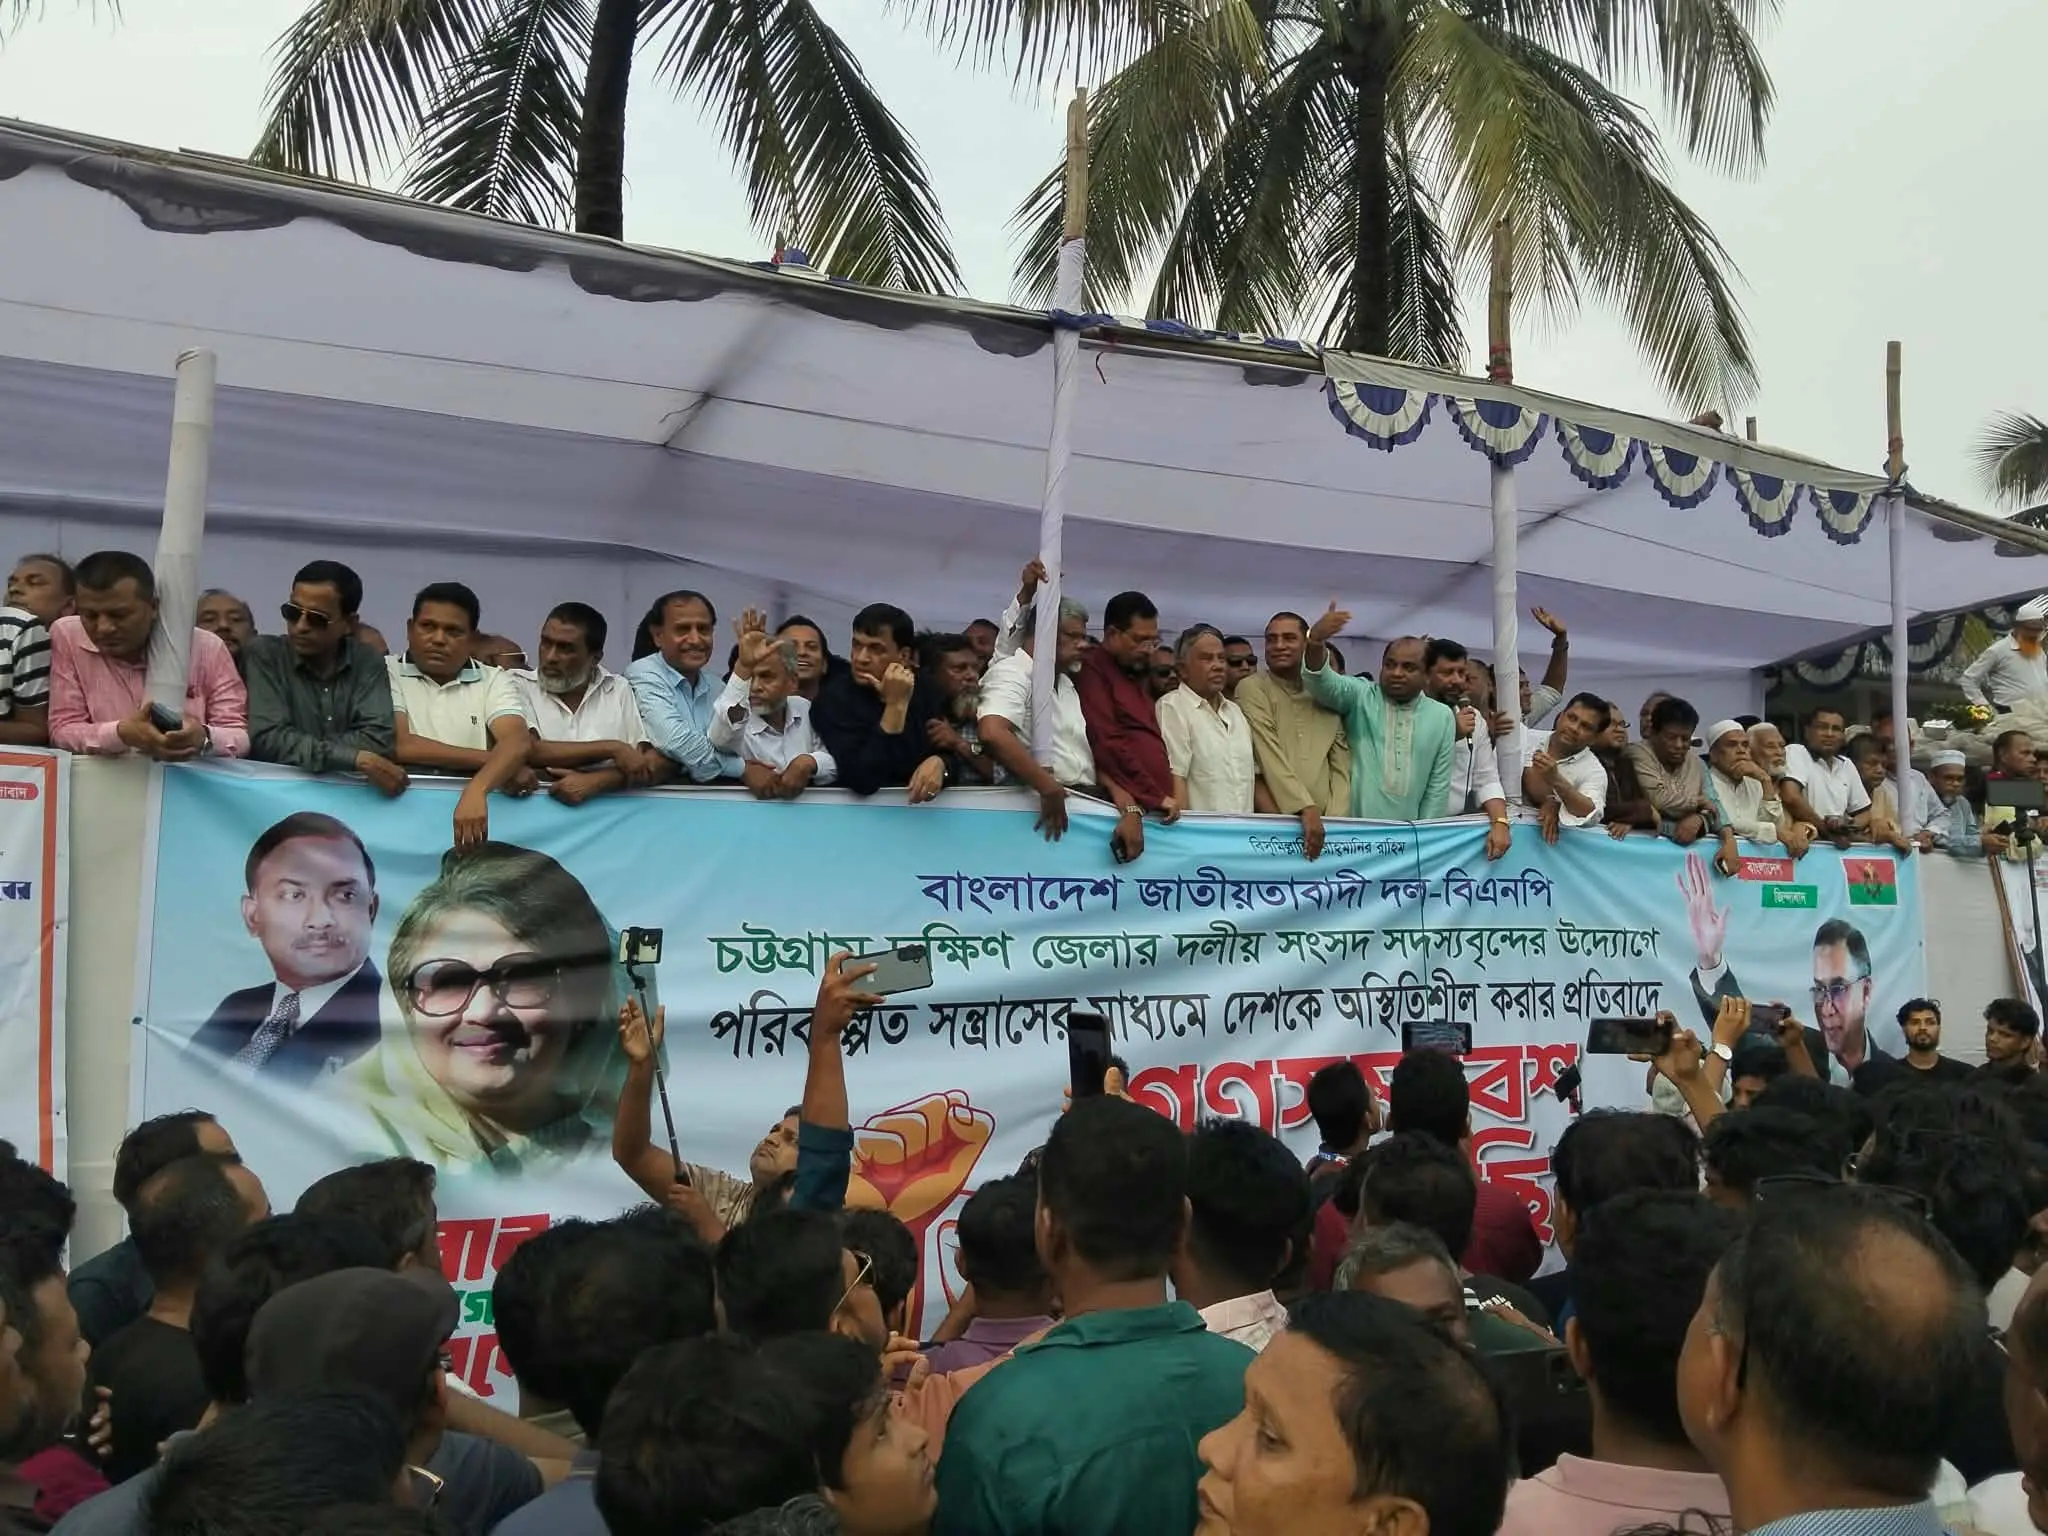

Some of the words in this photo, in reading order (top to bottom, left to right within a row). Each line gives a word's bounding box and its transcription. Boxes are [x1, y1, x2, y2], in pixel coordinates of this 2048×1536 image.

[917, 870, 1122, 913] বাংলাদেশ
[1134, 866, 1371, 912] জাতীয়তাবাদী
[1381, 867, 1554, 909] দল-বিএনপি
[1032, 932, 1161, 970] জেলার
[1172, 920, 1266, 965] দলীয়
[1278, 929, 1374, 965] সংসদ
[1383, 928, 1546, 970] সদস্যবৃন্দের
[1556, 918, 1660, 959] উদ্যোগে
[1224, 984, 1327, 1037] দেশকে
[1488, 980, 1555, 1020] করার
[1565, 968, 1662, 1019] প্রতিবাদে
